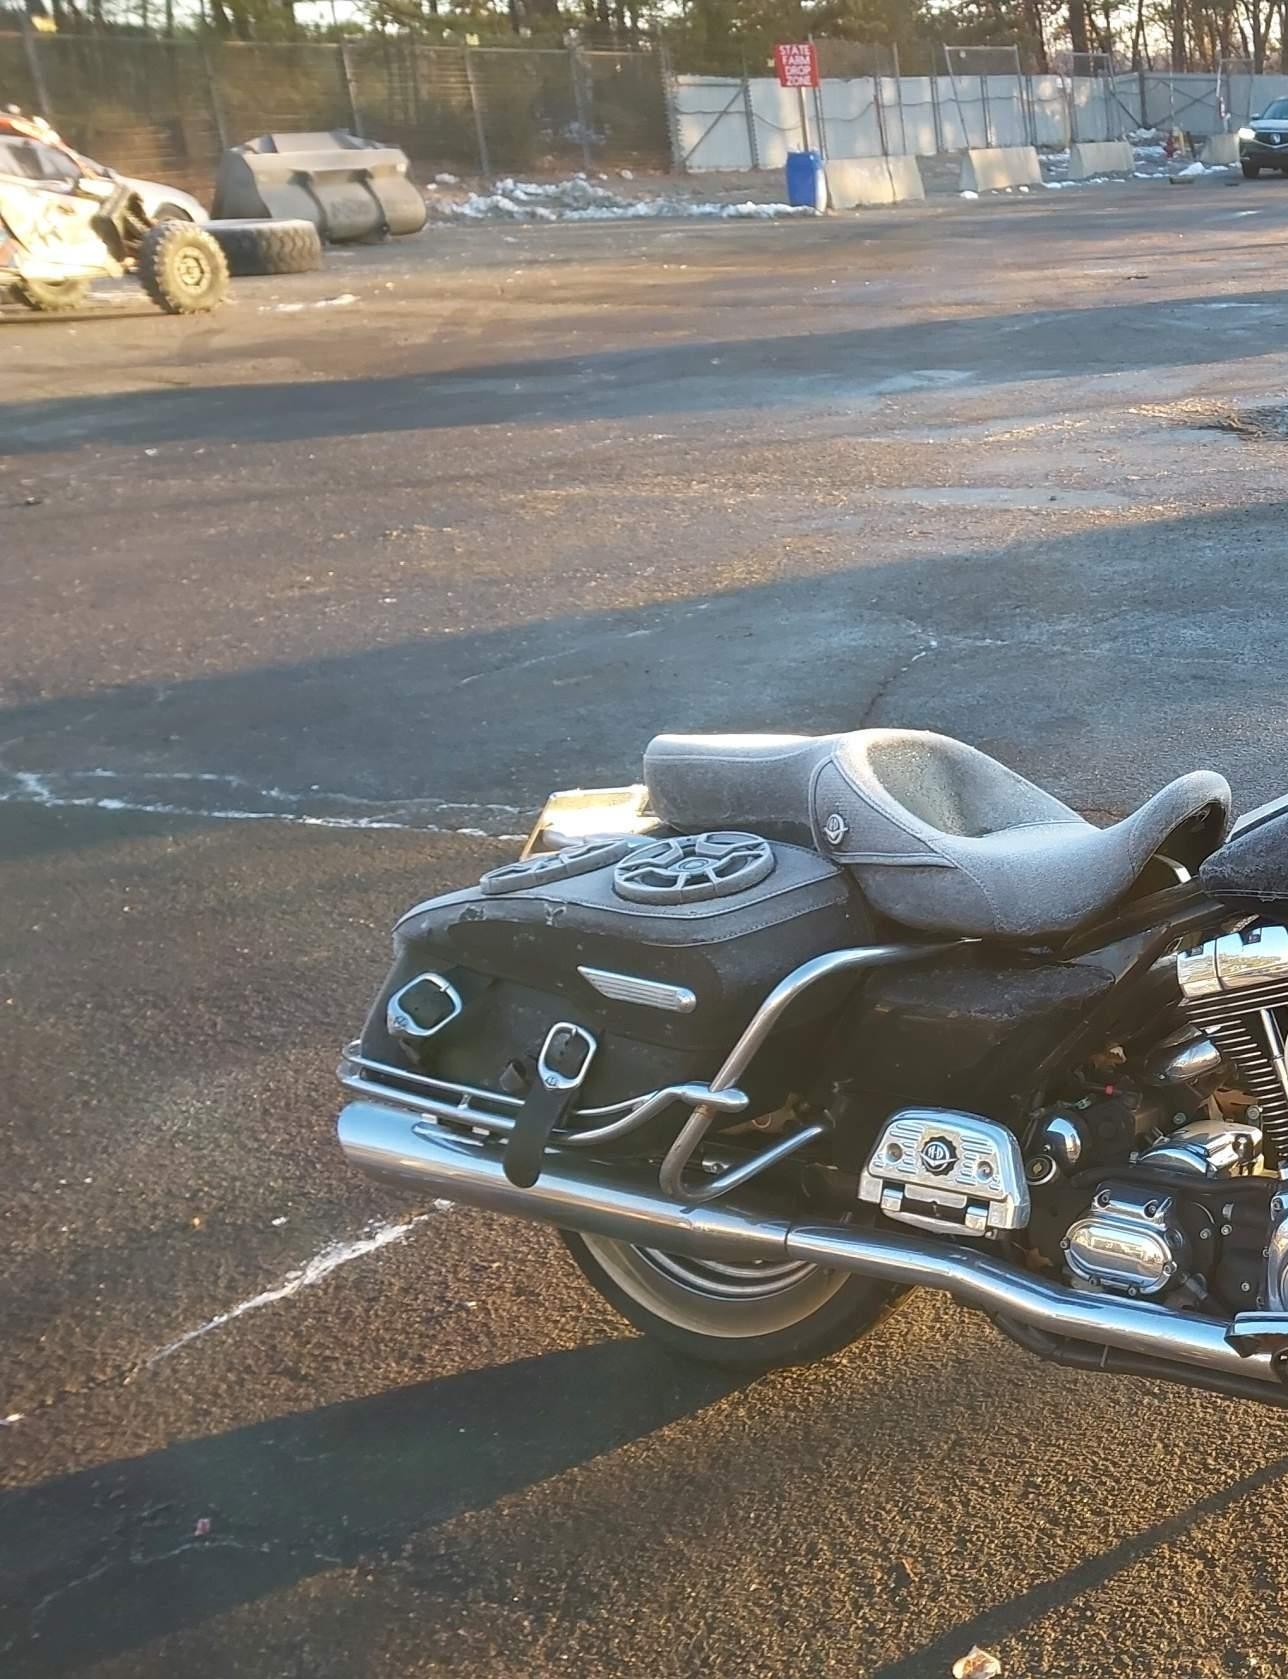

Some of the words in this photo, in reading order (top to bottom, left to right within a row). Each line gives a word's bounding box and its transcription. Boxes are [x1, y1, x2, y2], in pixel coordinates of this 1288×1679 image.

[779, 44, 811, 55] STATE
[782, 55, 811, 65] FARM
[785, 65, 812, 75] DROP
[786, 75, 812, 86] ZONE
